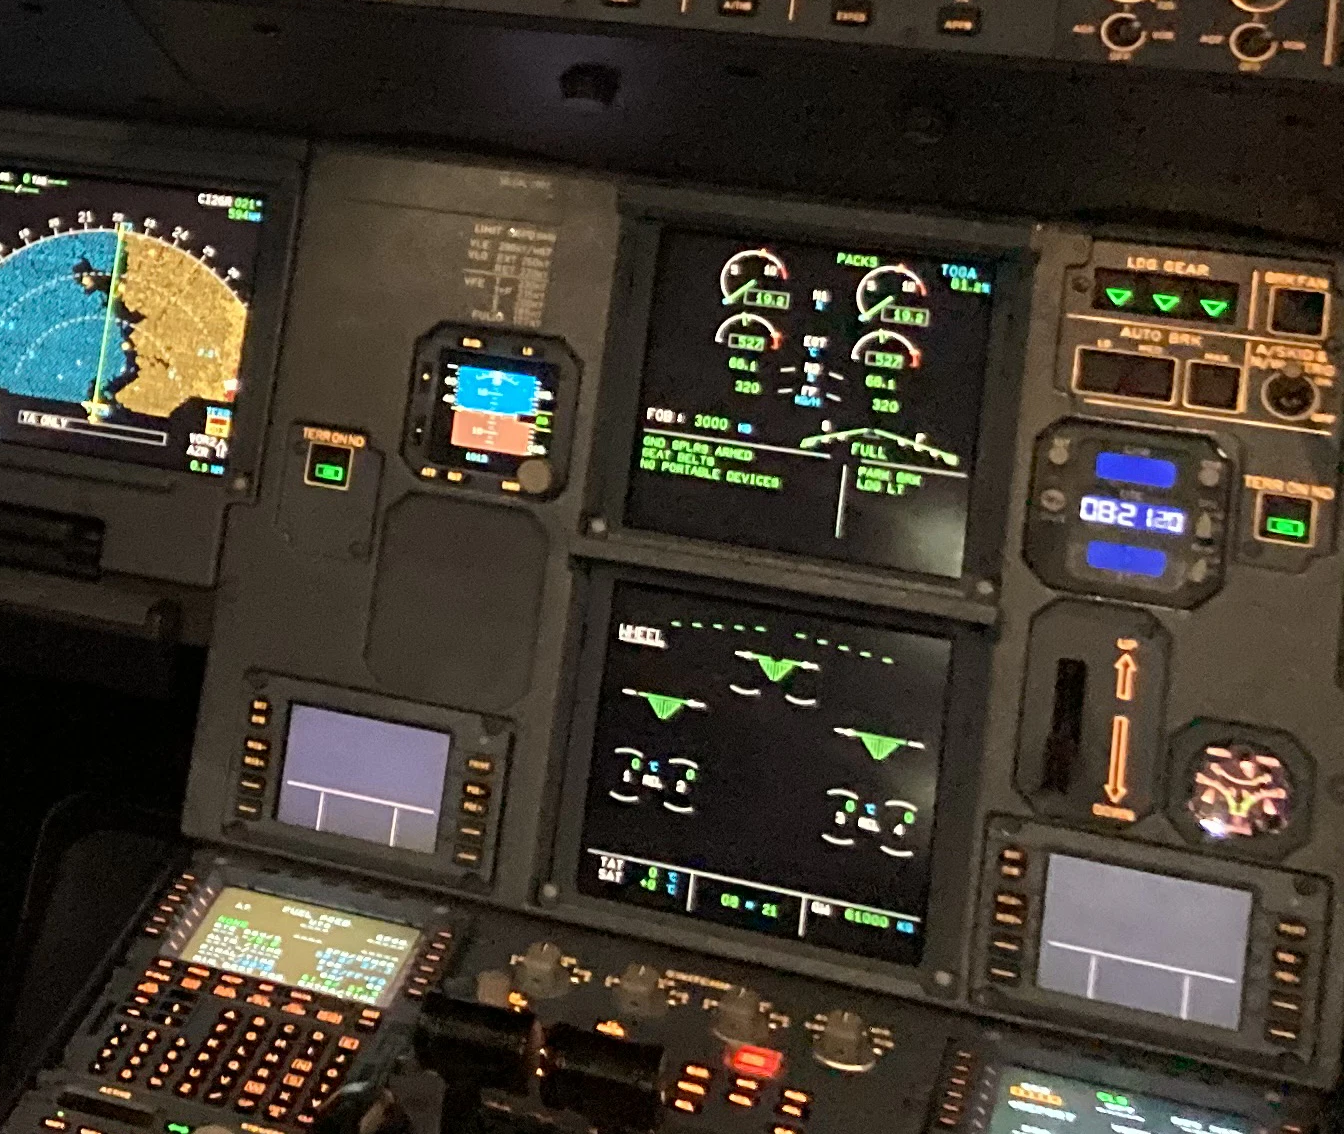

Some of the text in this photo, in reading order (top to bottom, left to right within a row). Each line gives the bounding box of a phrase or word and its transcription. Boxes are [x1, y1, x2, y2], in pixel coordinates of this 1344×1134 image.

[836, 252, 878, 269] PACKS
[1126, 256, 1210, 277] LDG GEAR
[764, 265, 779, 277] 10
[941, 263, 978, 280] TOGA
[902, 280, 917, 293] 10
[738, 334, 763, 349] 527
[1119, 327, 1203, 347] AUTO BRK
[875, 353, 903, 369] 527
[734, 379, 762, 395] 320
[872, 398, 900, 414] 320
[22, 412, 68, 428] TA ONLY
[694, 413, 729, 431] 3000
[303, 427, 366, 449] TERR ON ND
[641, 447, 716, 467] SEAT BELTS
[643, 435, 667, 449] GND
[714, 446, 755, 462] ARMED
[850, 441, 888, 460] FULL
[640, 458, 783, 489] NO PORTABLE DEVICES
[857, 466, 890, 482] PARK
[618, 622, 663, 645] WHEEL
[600, 856, 625, 872] TAT
[598, 868, 624, 884] SAT
